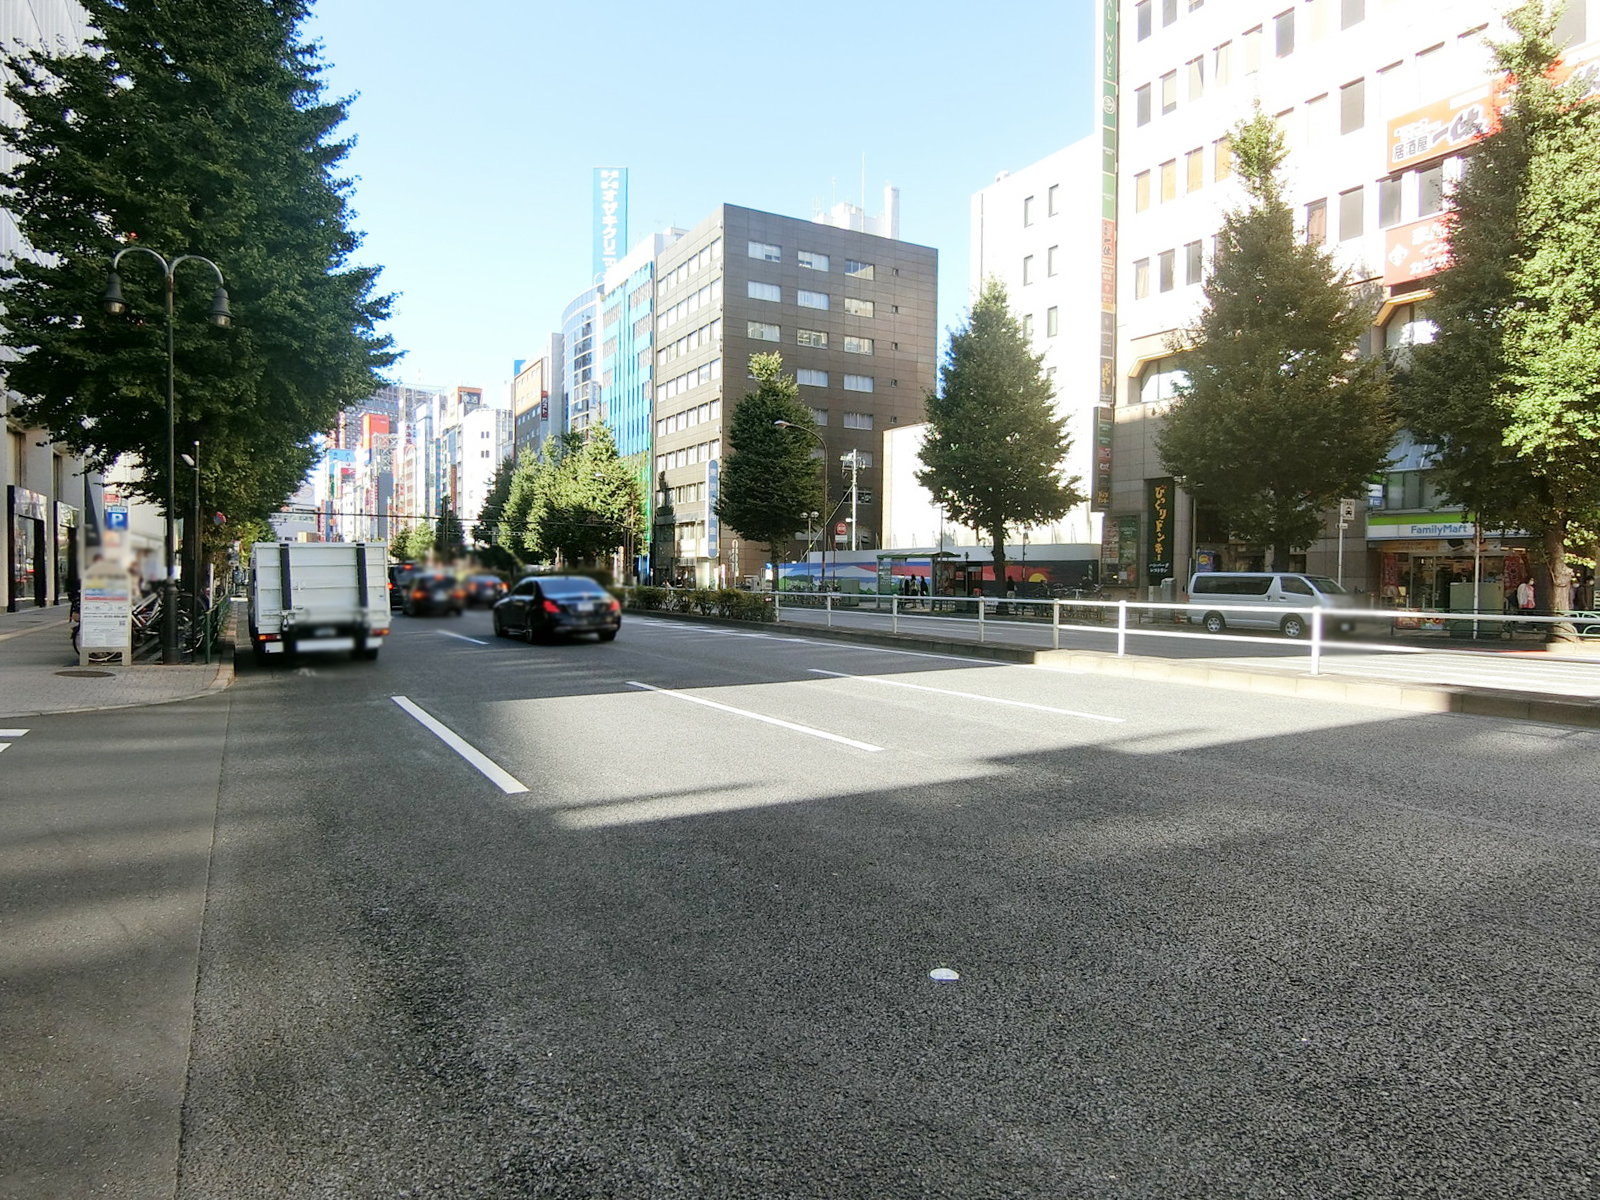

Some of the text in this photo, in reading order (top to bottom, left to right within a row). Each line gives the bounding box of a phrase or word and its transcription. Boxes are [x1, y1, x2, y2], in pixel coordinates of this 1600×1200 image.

[1106, 32, 1114, 77] WAVE
[111, 513, 124, 525] P
[1154, 485, 1168, 561] びっくりドンキー
[1410, 524, 1467, 536] FamilyMart
